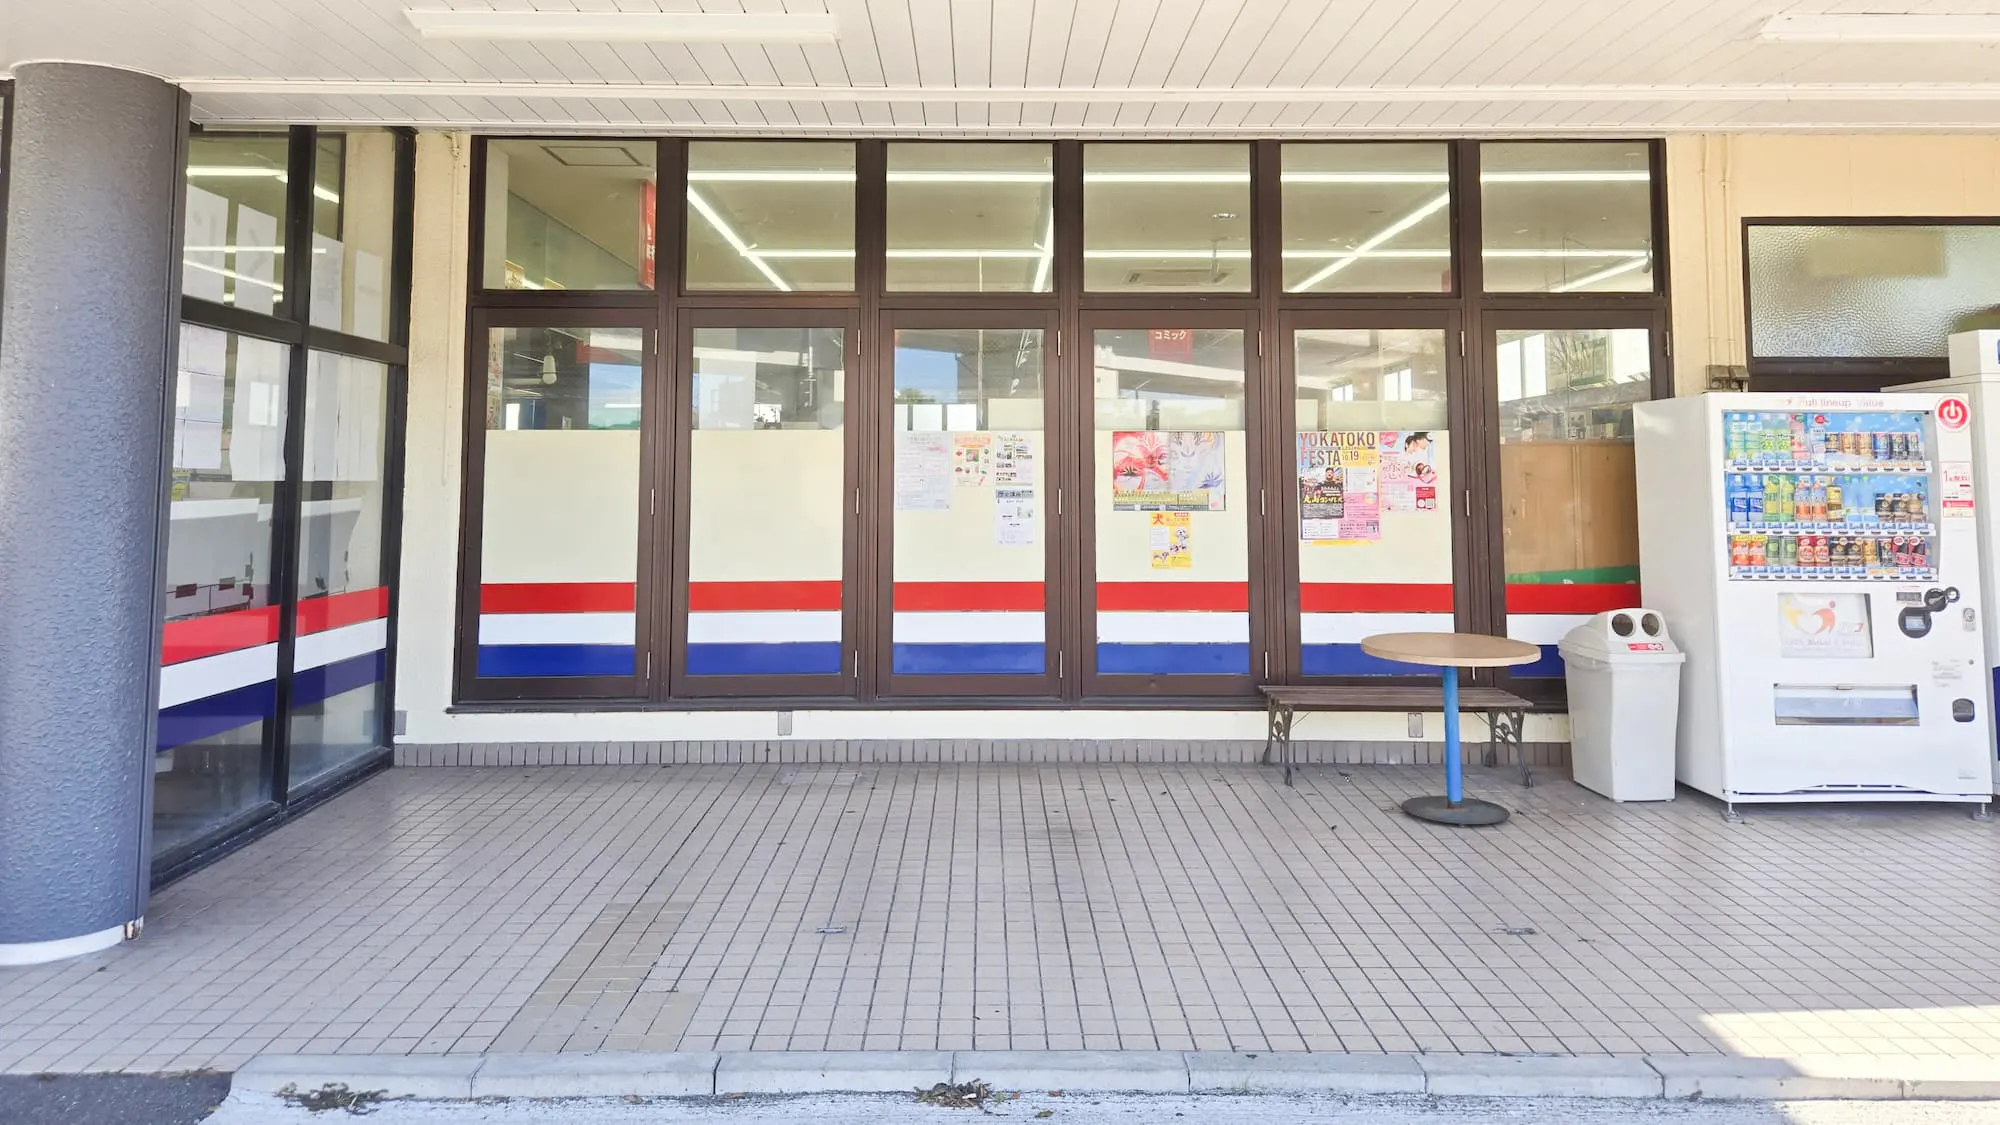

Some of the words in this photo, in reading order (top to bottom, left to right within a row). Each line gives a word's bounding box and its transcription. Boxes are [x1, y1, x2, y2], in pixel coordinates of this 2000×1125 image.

[1155, 329, 1187, 340] コミック
[1300, 432, 1375, 446] YOKATOKO
[1301, 450, 1341, 466] FESTA
